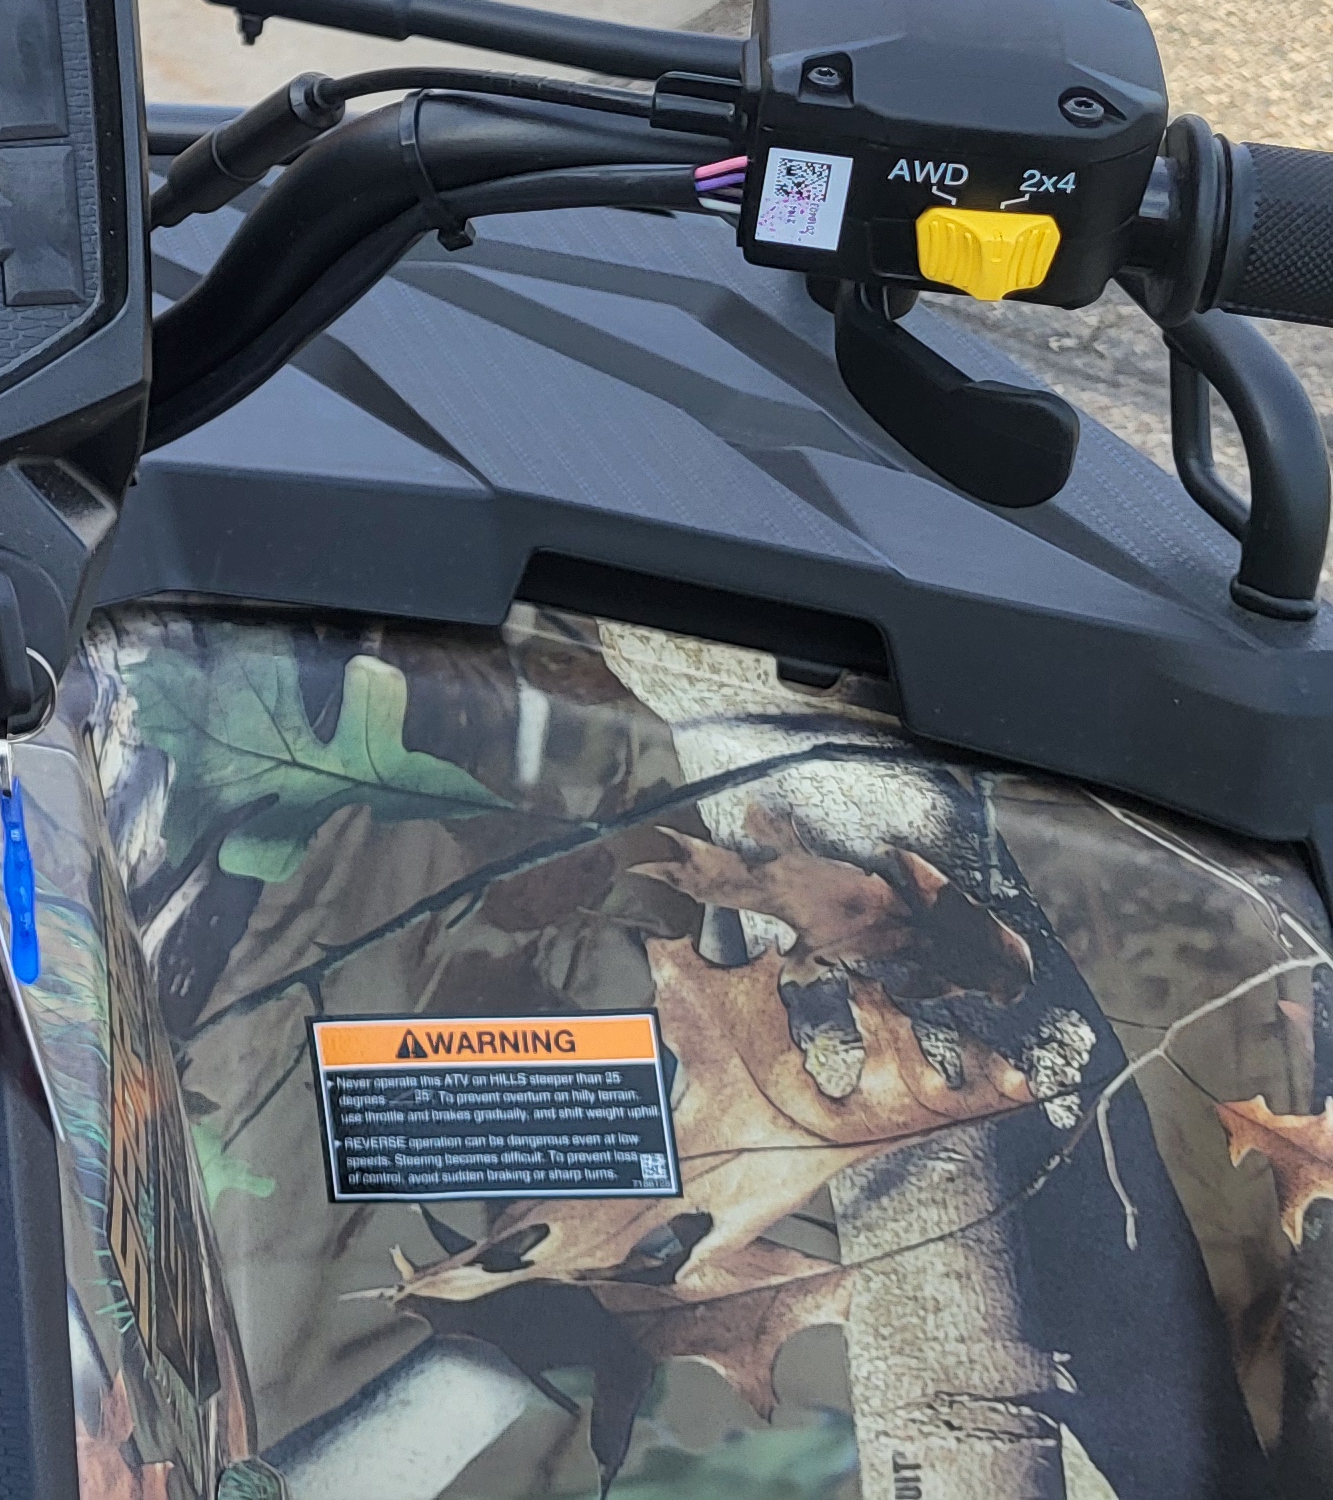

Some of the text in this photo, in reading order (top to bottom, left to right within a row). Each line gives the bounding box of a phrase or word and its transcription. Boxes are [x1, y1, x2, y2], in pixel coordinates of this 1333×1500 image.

[888, 160, 1076, 194] AWD 2x4
[425, 1029, 576, 1055] WARNING
